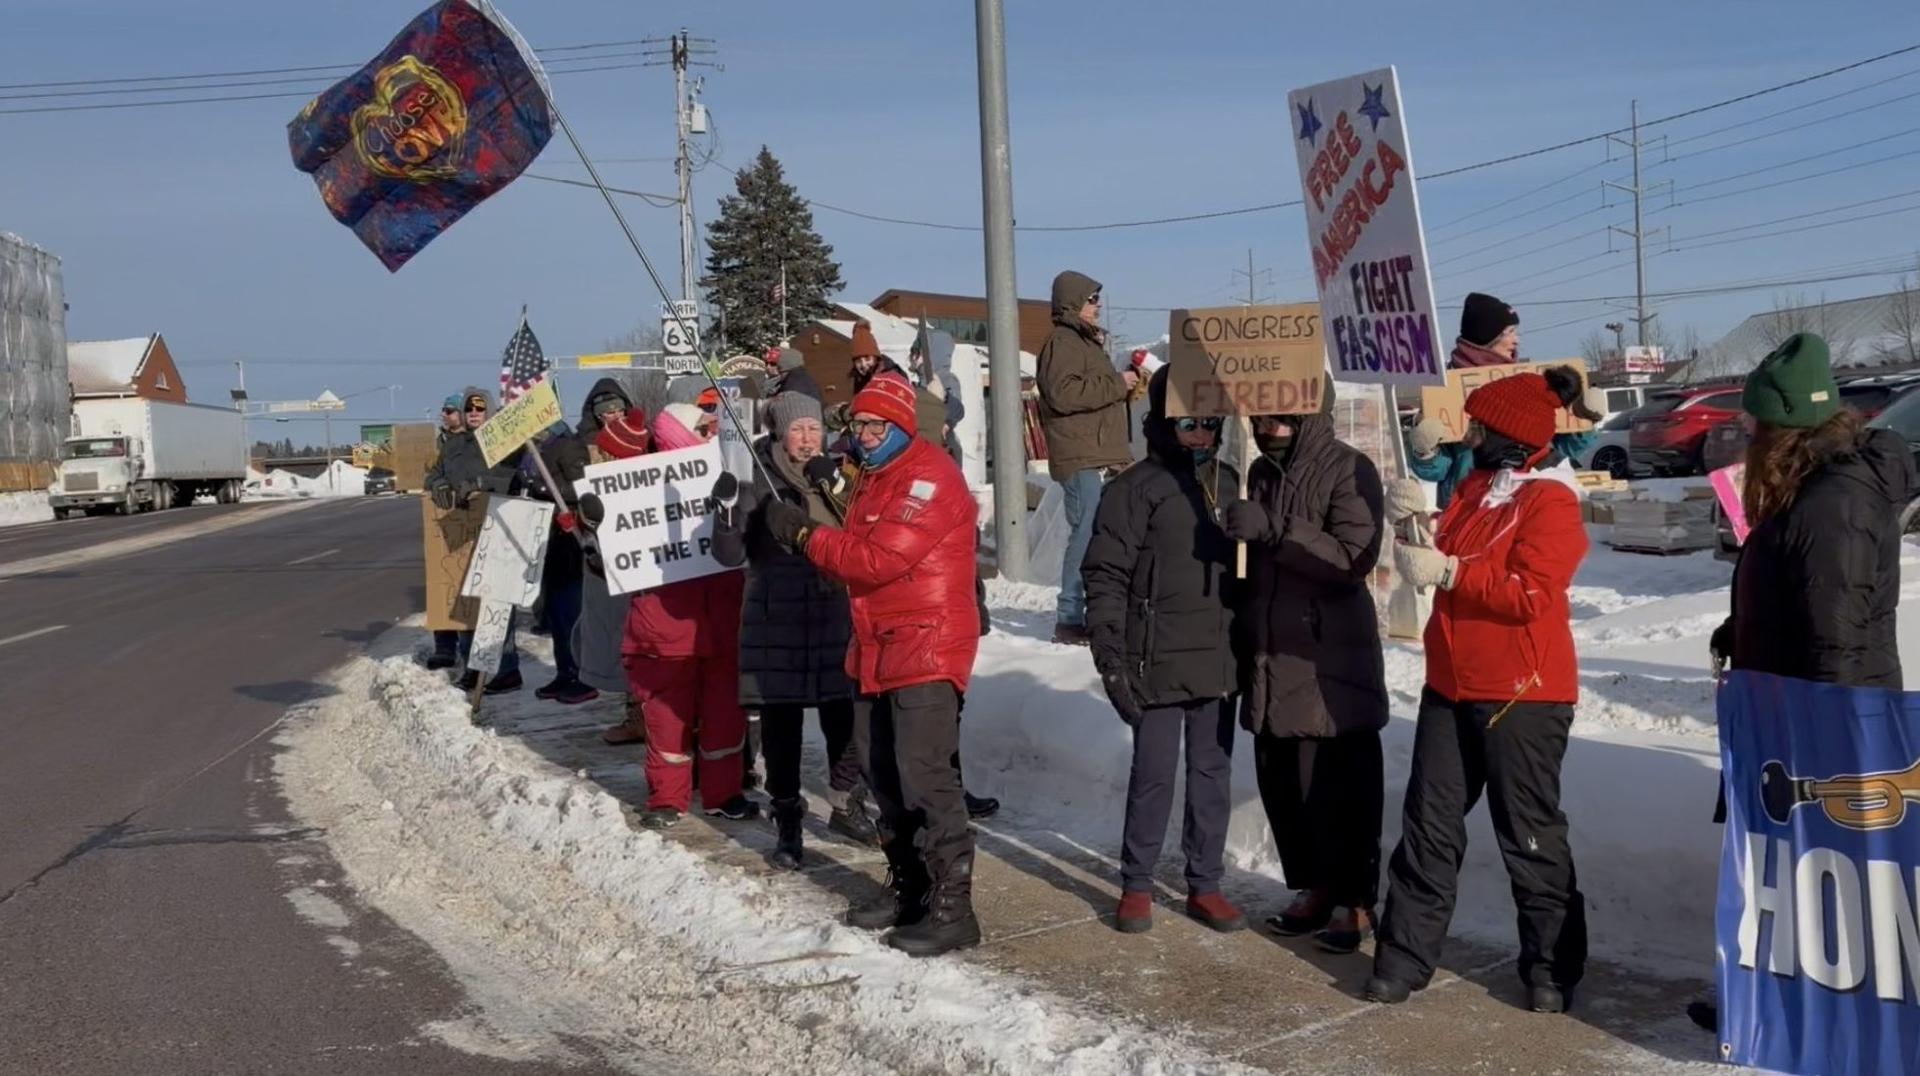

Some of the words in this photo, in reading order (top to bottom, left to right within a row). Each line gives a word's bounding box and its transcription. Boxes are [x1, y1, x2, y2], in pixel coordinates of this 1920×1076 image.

[367, 92, 435, 153] Choose
[1306, 110, 1362, 213] FREE
[1311, 139, 1406, 291] AMERICA
[1350, 255, 1416, 315] FIGHT
[662, 303, 697, 315] NRTH
[667, 325, 695, 346] 63
[1182, 315, 1319, 342] CONGRESS
[1332, 313, 1437, 376] FASCISM
[667, 359, 701, 370] NORTH
[1191, 377, 1319, 412] FIRED!!
[589, 467, 662, 497] TRUMP
[664, 459, 708, 483] AND
[615, 508, 659, 532] ARE
[614, 550, 642, 571] OF
[649, 541, 692, 565] THE
